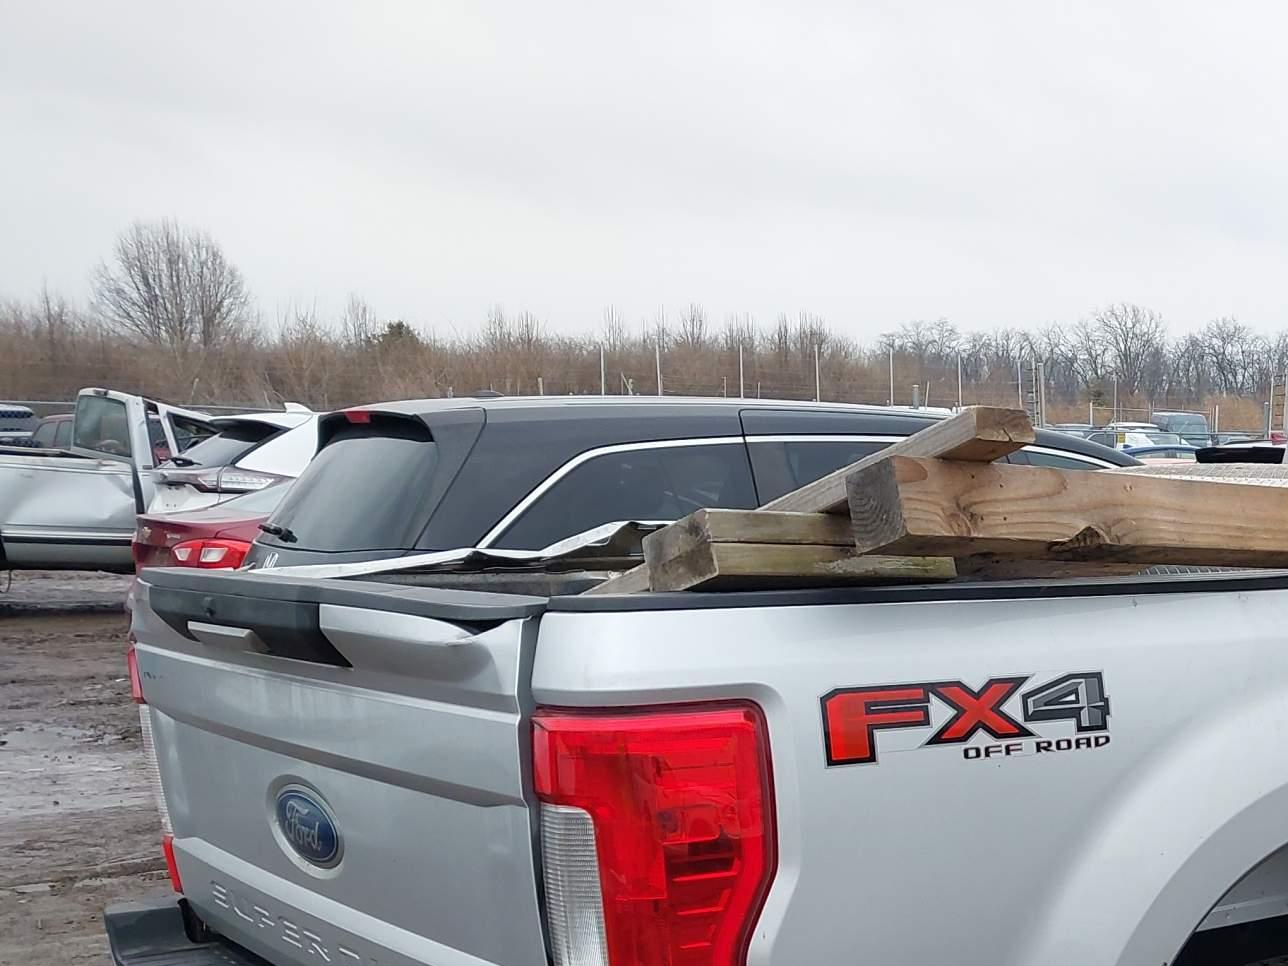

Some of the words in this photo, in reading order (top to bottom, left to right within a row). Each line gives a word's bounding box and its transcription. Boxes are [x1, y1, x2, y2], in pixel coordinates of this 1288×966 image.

[819, 669, 1111, 768] FX4
[963, 742, 1023, 761] OFF
[1035, 735, 1111, 755] ROAD
[284, 799, 322, 851] Ford
[210, 880, 332, 963] SUPER
